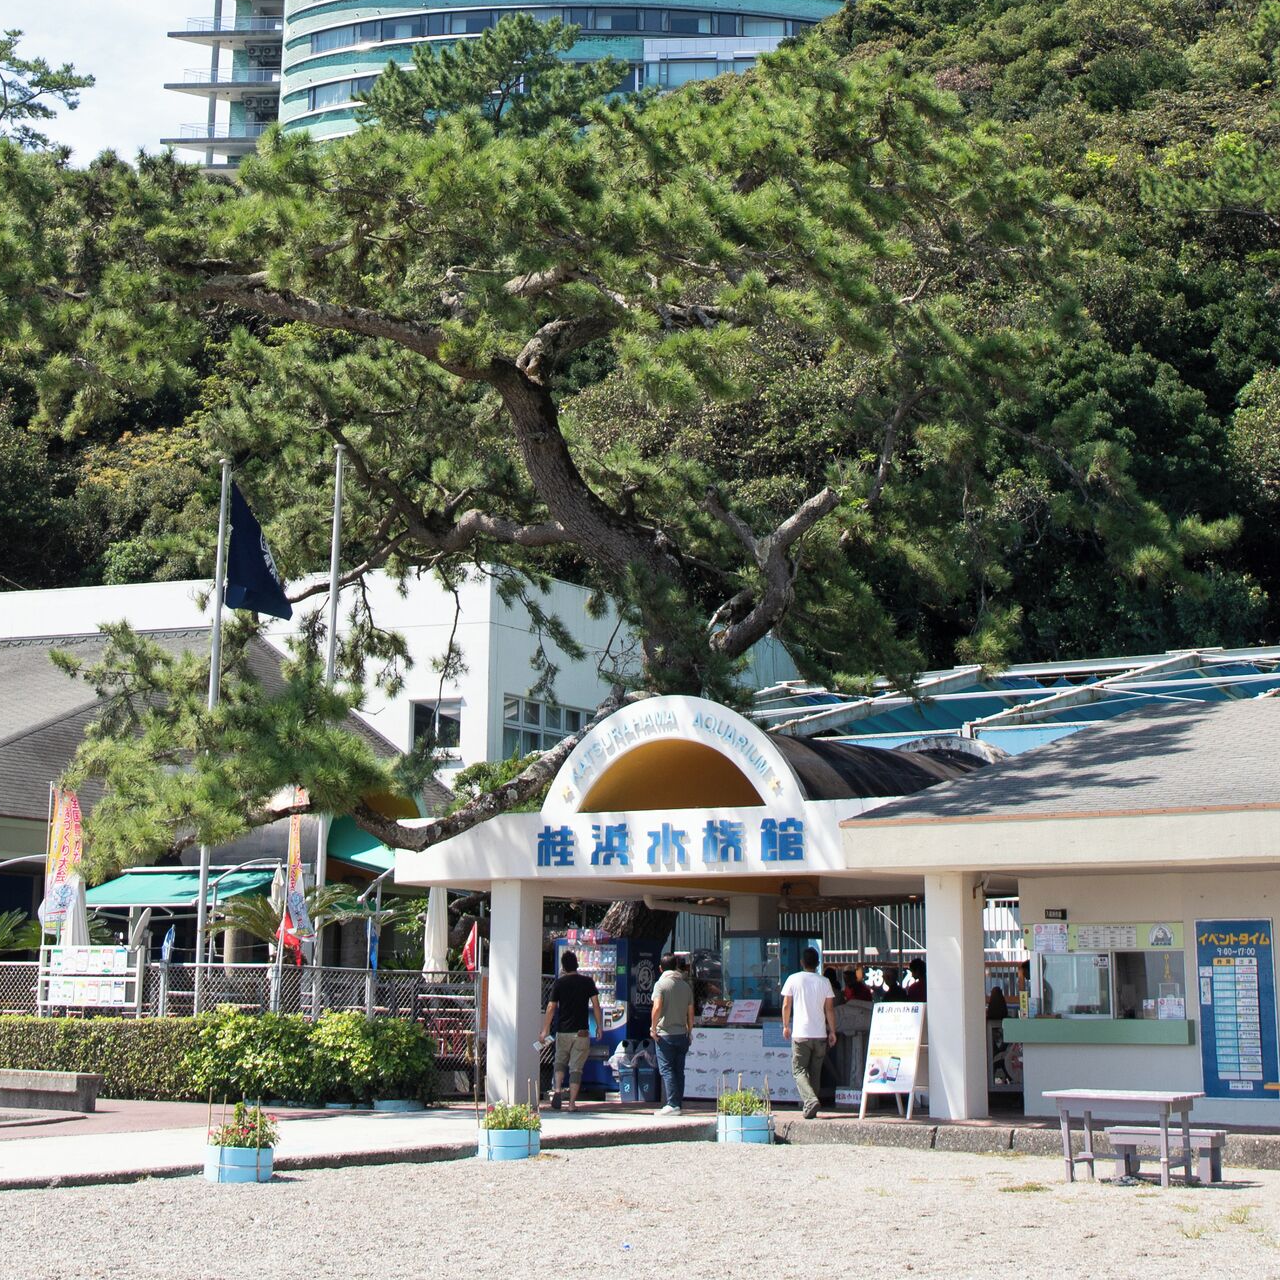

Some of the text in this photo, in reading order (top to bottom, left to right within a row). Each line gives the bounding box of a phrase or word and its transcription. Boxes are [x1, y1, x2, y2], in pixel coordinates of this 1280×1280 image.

[572, 711, 769, 784] KATSURAHAMA AQUARIUM
[537, 817, 804, 867] 桂浜水族館
[1198, 932, 1270, 946] イベントタイム
[636, 993, 652, 1005] BOS
